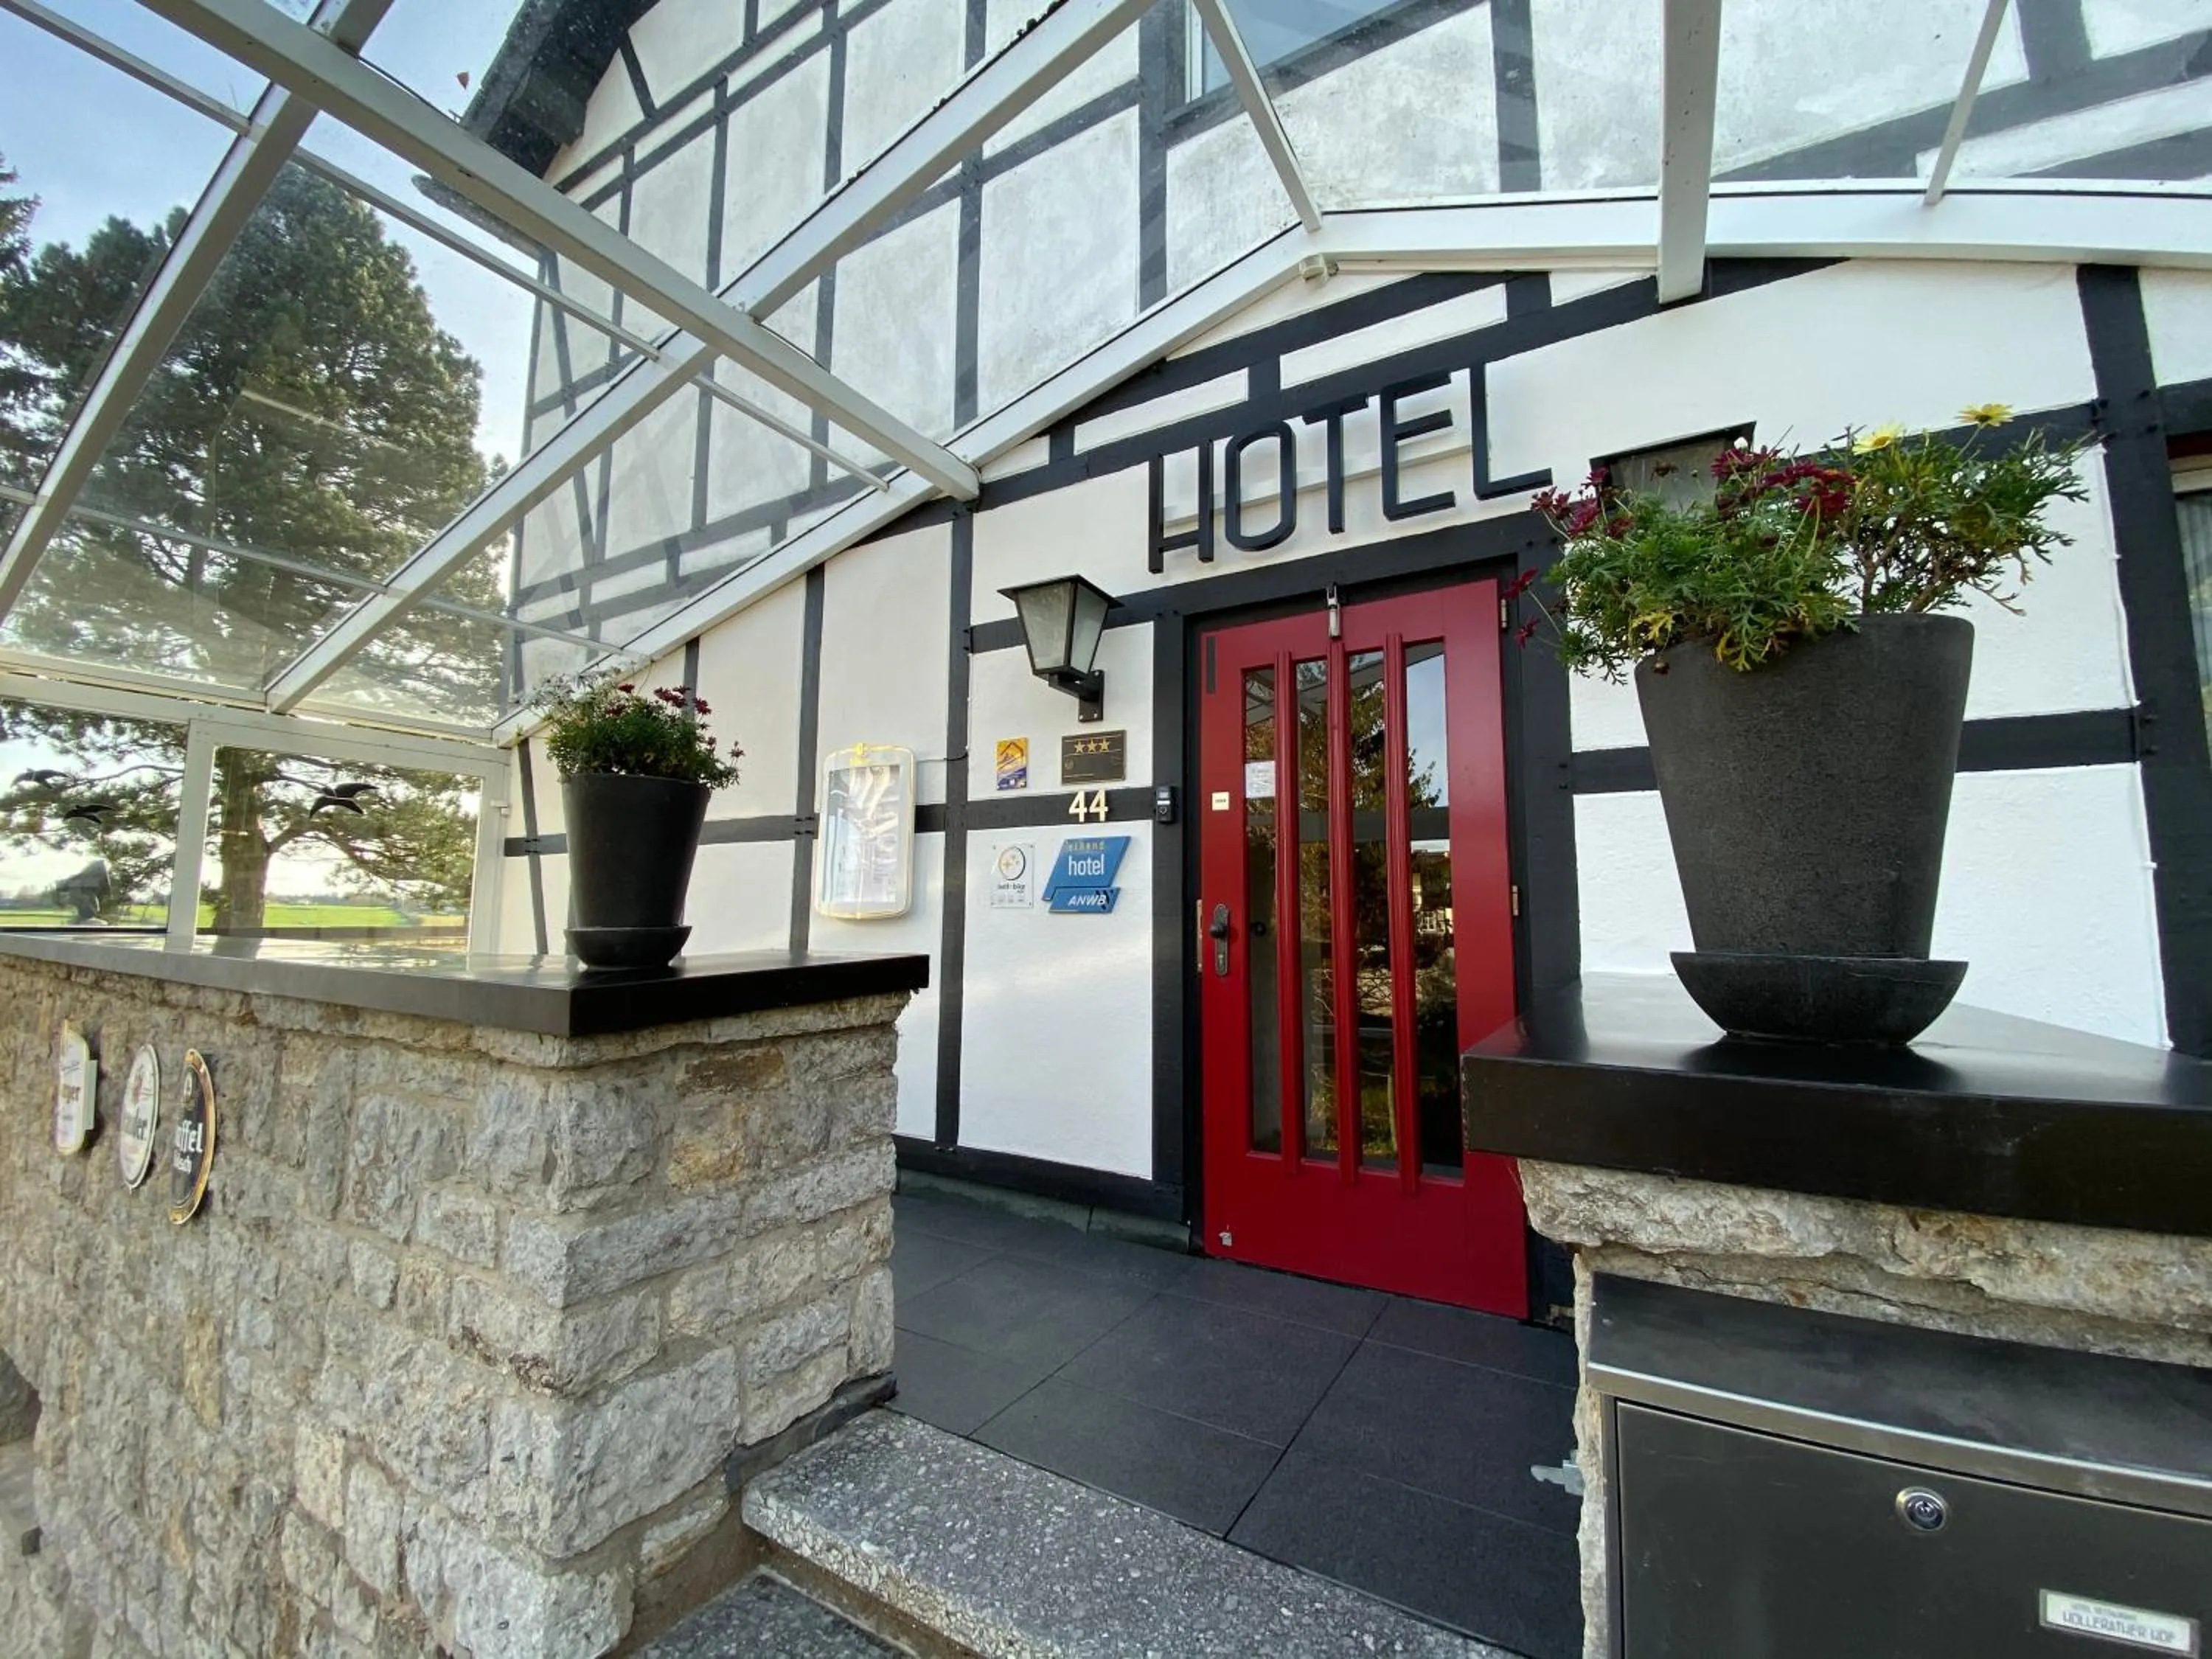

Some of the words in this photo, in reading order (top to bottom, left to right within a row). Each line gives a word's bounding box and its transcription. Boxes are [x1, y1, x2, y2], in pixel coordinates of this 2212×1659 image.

[1147, 360, 1554, 574] HOTEL
[1068, 790, 1108, 823] 44
[1068, 854, 1105, 876] hotel
[1068, 894, 1107, 907] ANWB
